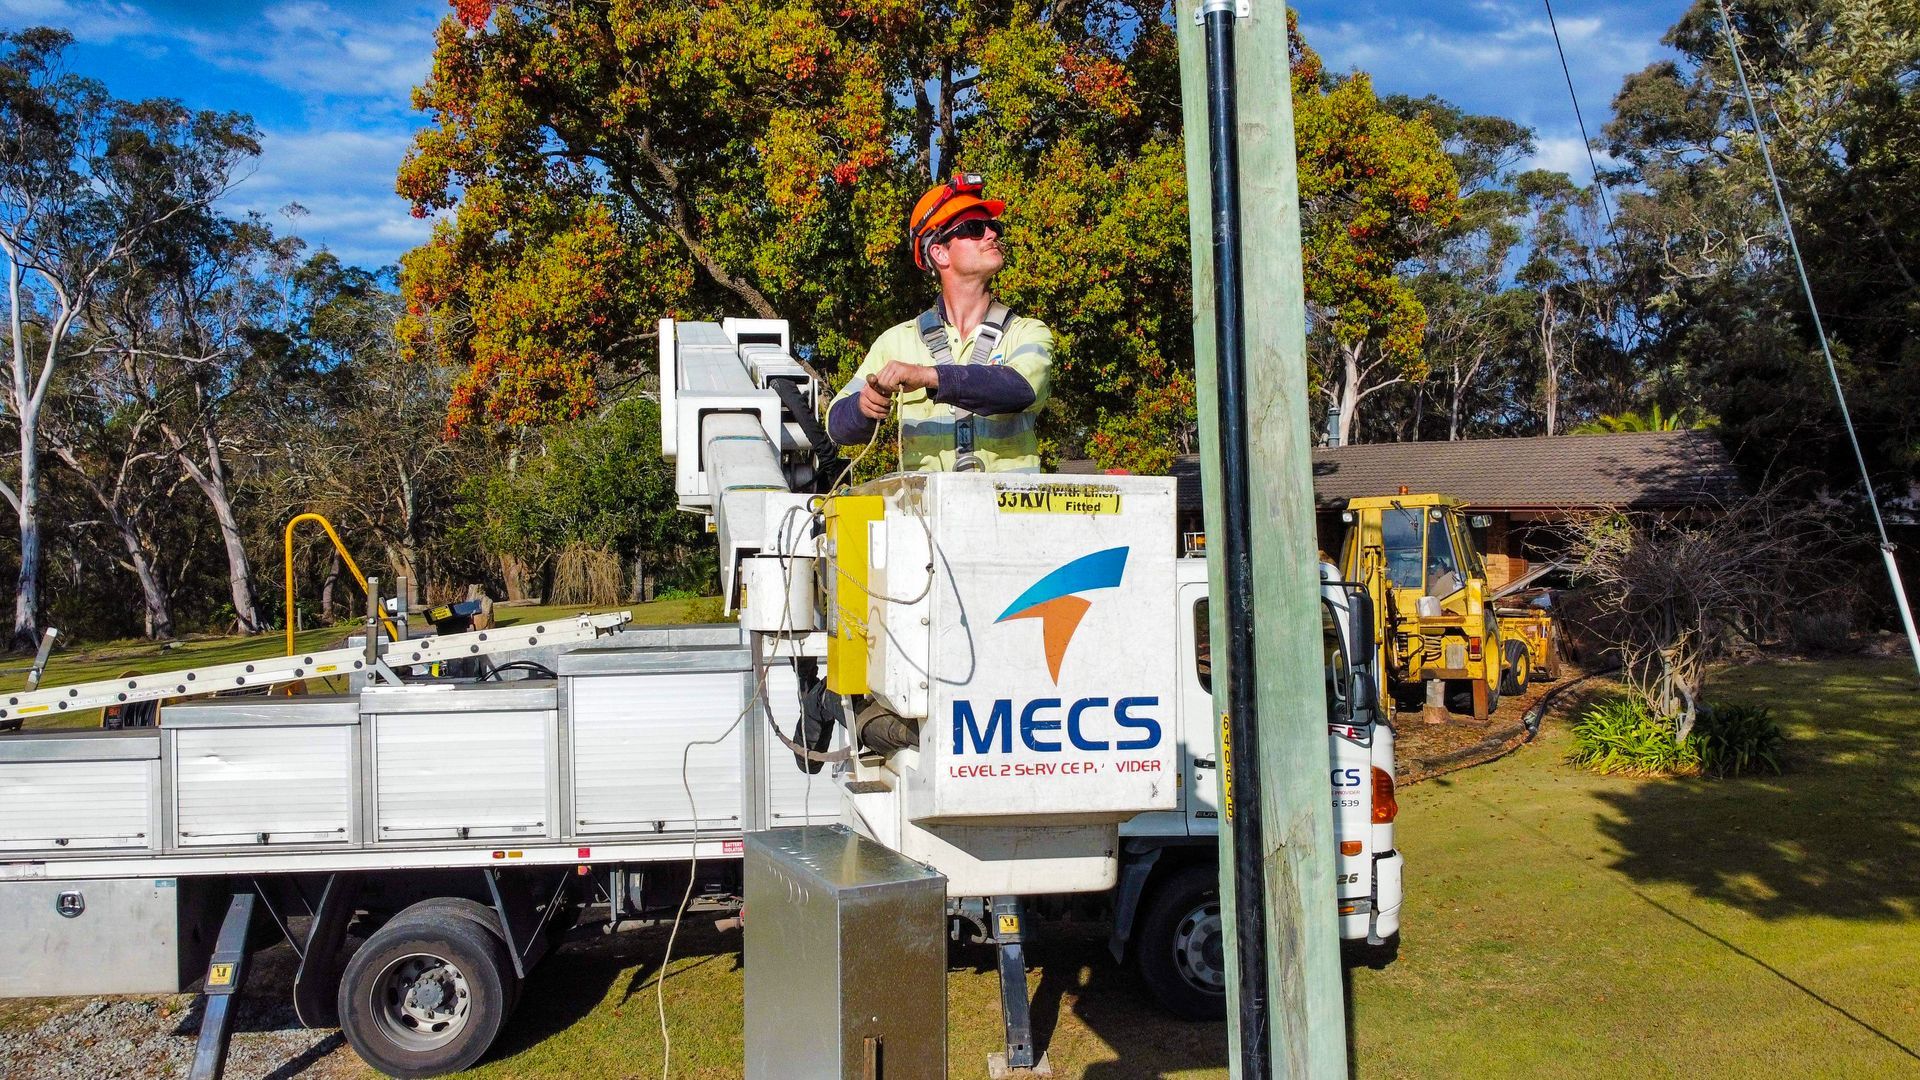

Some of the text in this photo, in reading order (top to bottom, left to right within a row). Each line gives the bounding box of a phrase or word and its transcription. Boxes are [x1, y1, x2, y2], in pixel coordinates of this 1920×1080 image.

[1065, 501, 1101, 511] Fitted
[952, 696, 1162, 755] MECS
[950, 760, 1161, 778] LEVEL 2 SERVCE PVIDER
[1330, 769, 1361, 787] CS
[1341, 799, 1360, 807] 539
